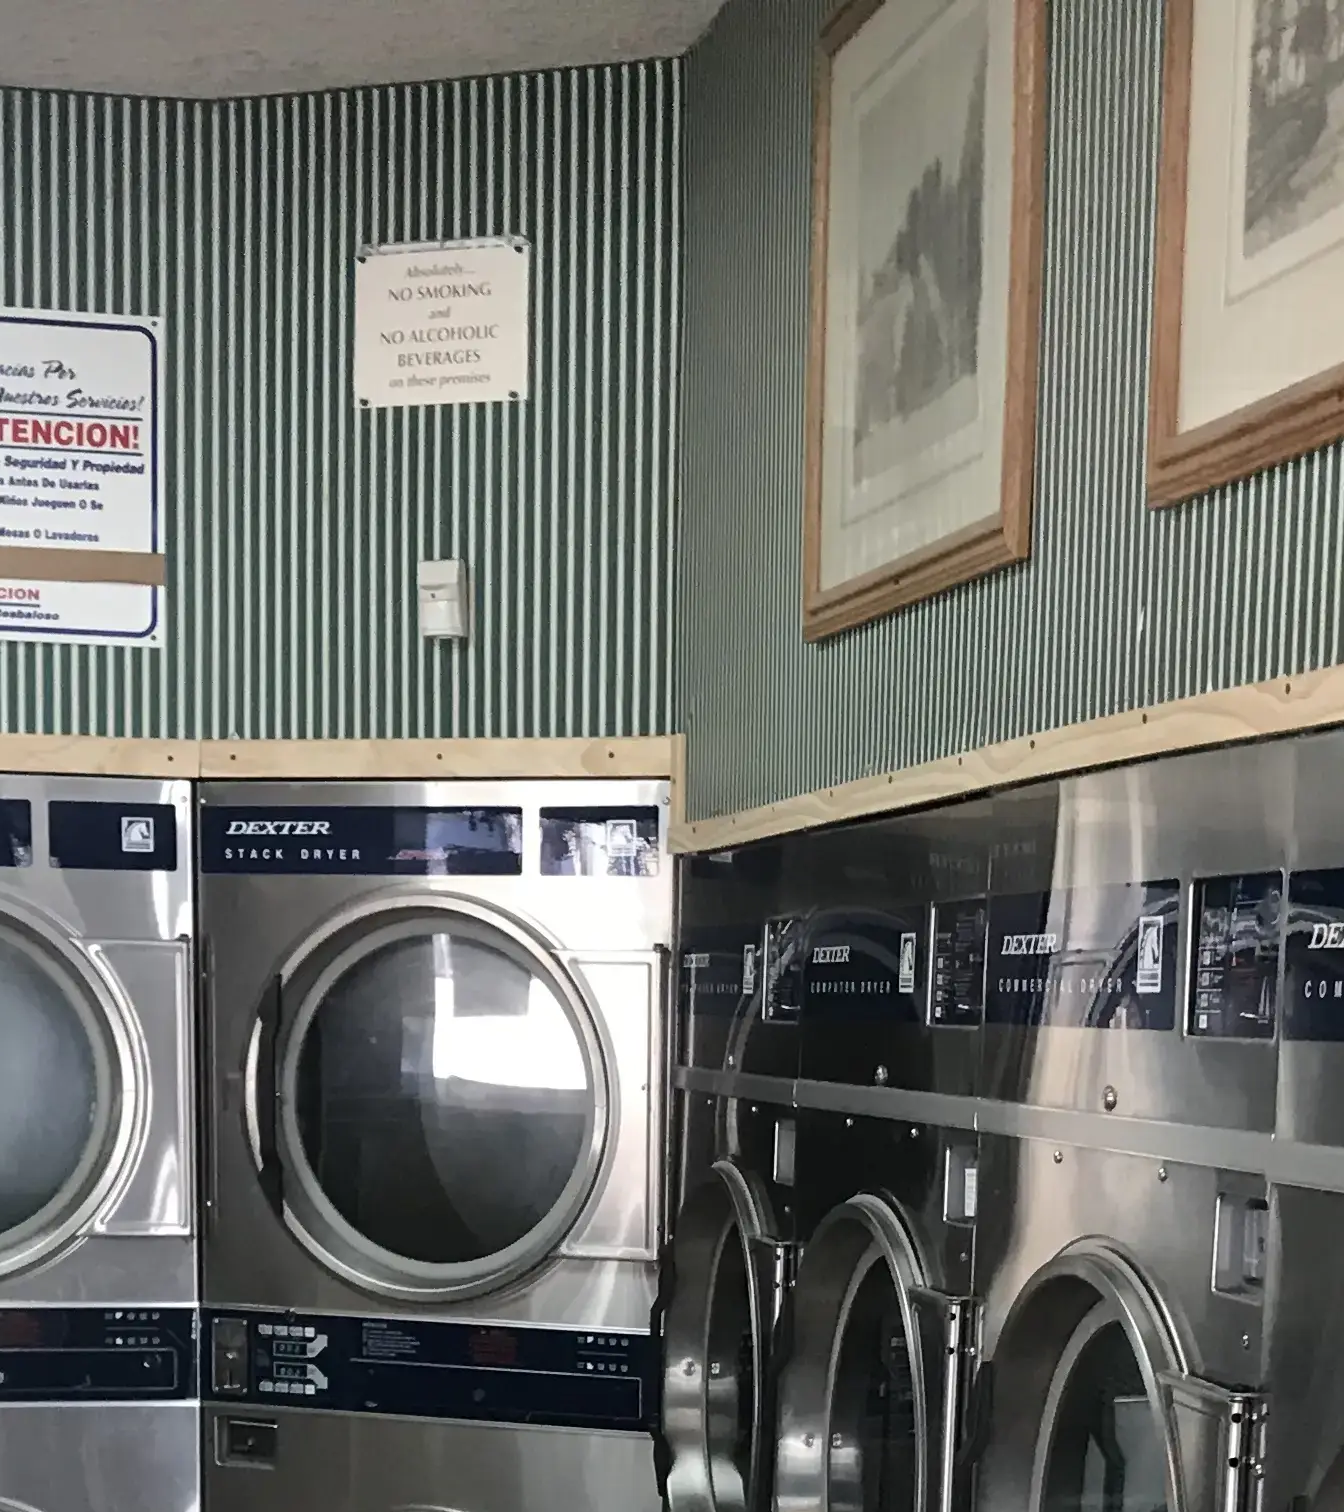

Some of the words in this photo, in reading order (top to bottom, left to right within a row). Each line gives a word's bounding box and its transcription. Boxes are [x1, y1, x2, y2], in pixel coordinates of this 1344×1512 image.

[388, 287, 413, 301] NO
[416, 281, 492, 300] SMOKING
[428, 306, 451, 319] and
[380, 330, 405, 345] NO
[408, 324, 500, 344] ALCOHOLIC
[397, 349, 481, 367] BEVERAGES
[42, 360, 77, 380] Por
[407, 374, 437, 387] these
[439, 372, 491, 389] premises
[67, 388, 145, 411] Servicios!
[4, 456, 66, 470] Seguridad
[71, 459, 79, 471] Y
[83, 460, 145, 474] Propiedad
[8, 476, 38, 487] Antes
[42, 477, 55, 488] De
[79, 499, 87, 509] O
[91, 500, 103, 510] Se
[33, 528, 41, 539] O
[226, 820, 331, 836] DEXTER
[225, 848, 284, 860] STACK
[301, 848, 360, 860] DRYER
[1000, 933, 1058, 955] DEXTER
[812, 946, 851, 963] DEXTER
